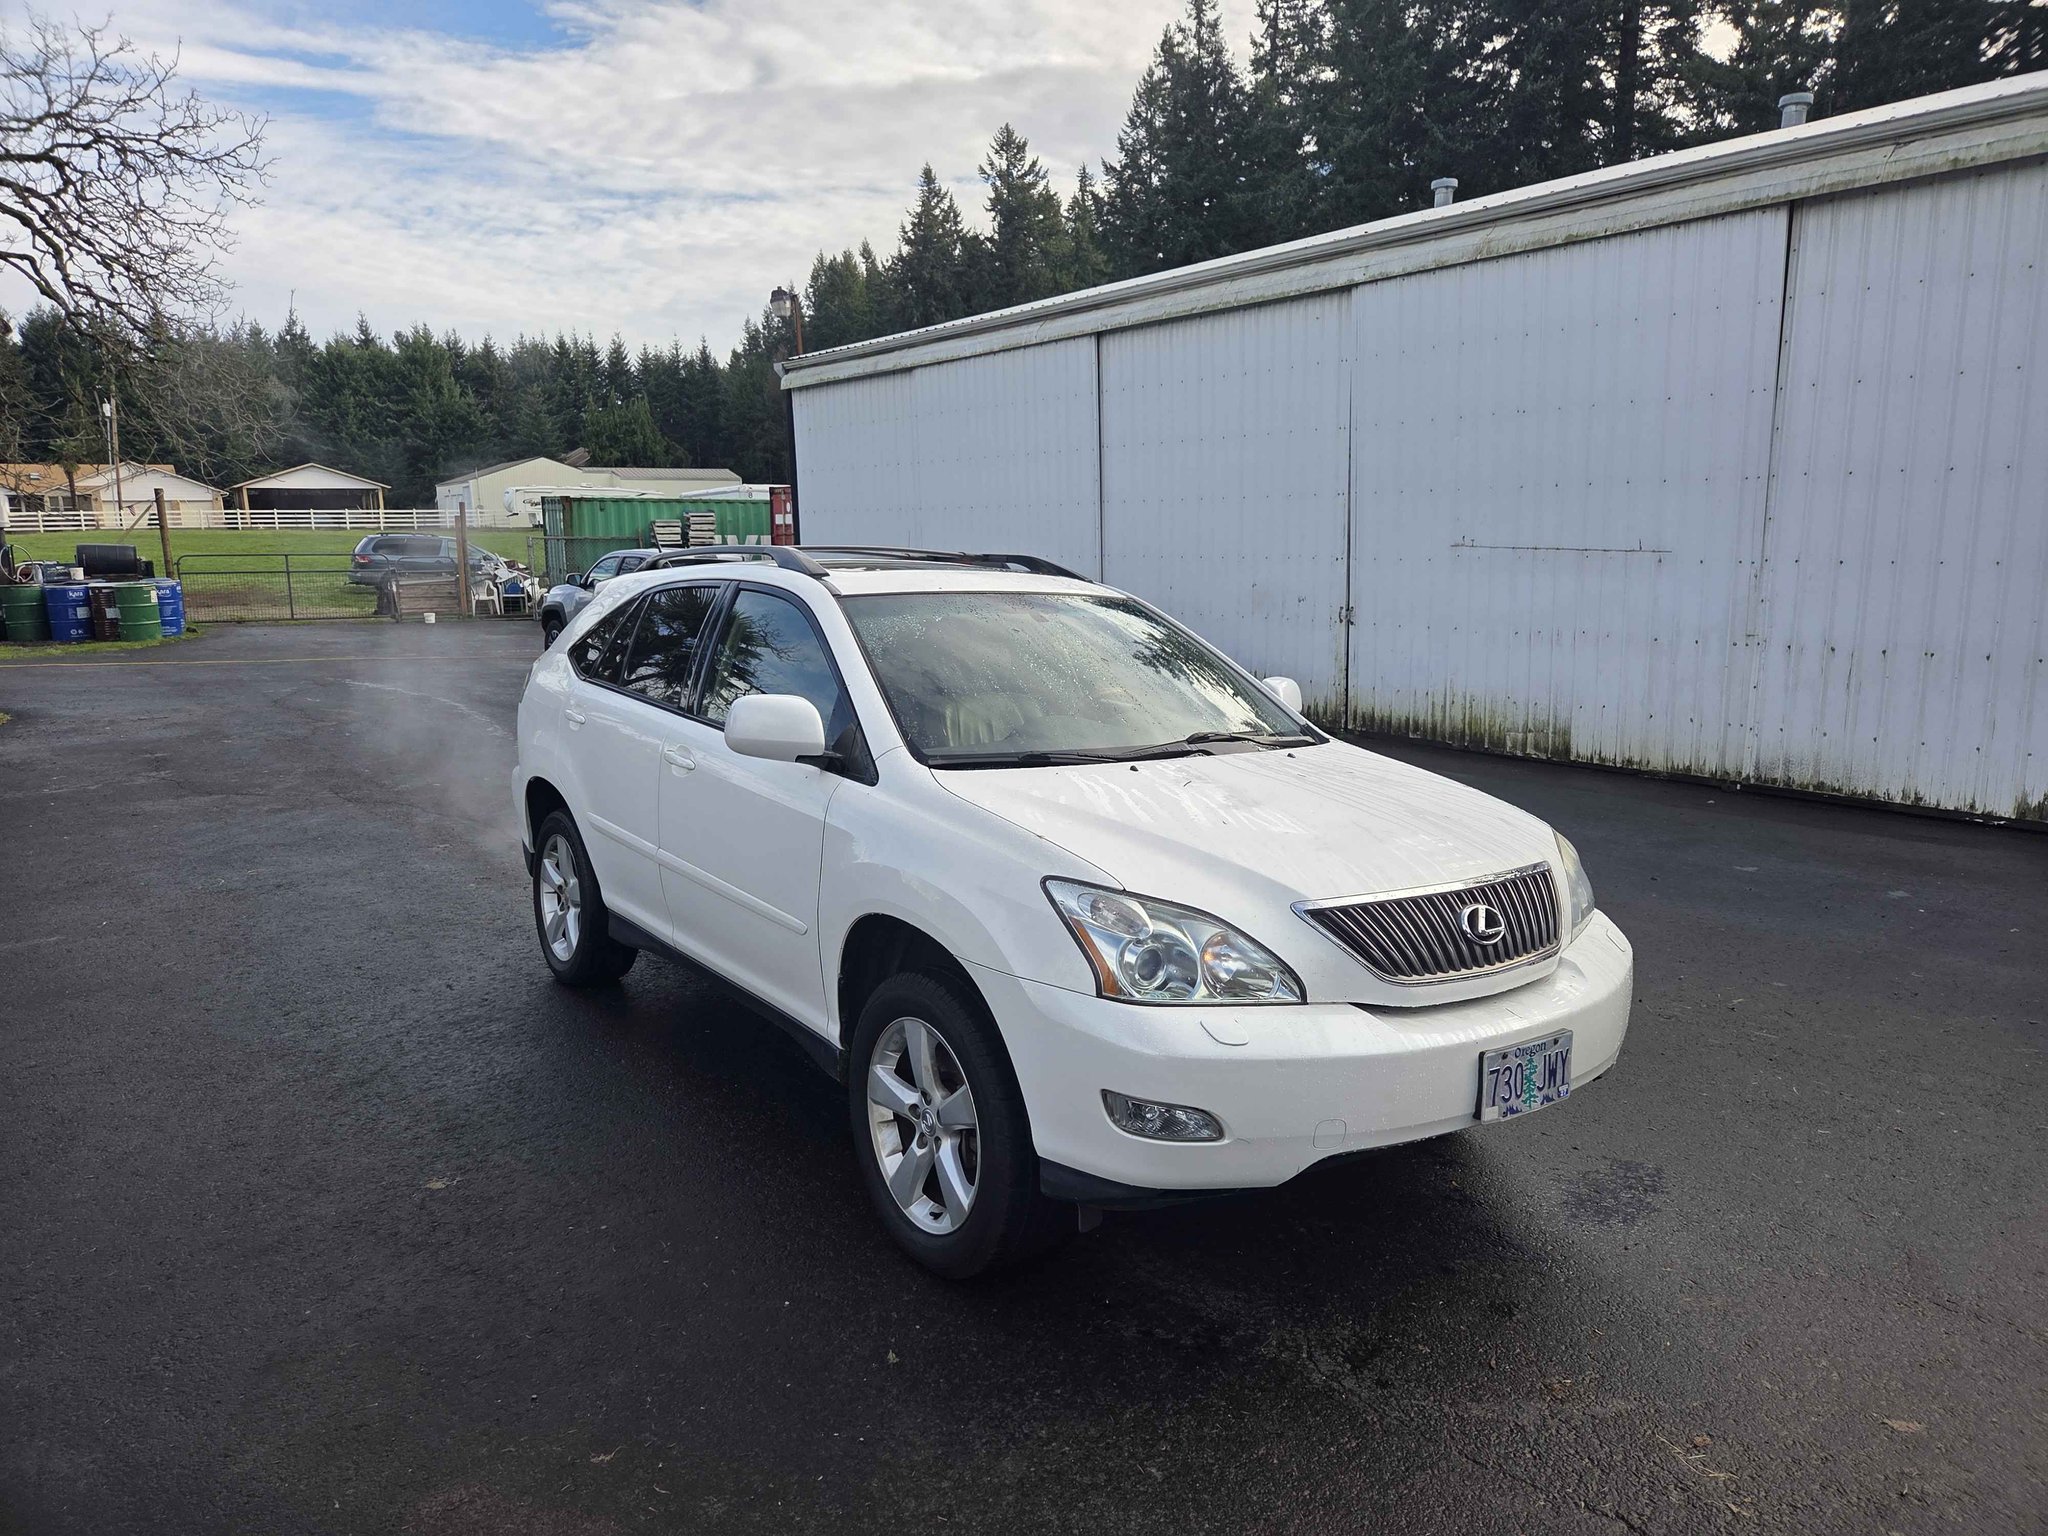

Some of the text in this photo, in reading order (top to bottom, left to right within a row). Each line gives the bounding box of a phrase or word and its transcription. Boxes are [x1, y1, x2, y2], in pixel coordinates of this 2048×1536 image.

[1514, 1041, 1547, 1059] Oregon
[1489, 1048, 1569, 1107] 730 JWY
